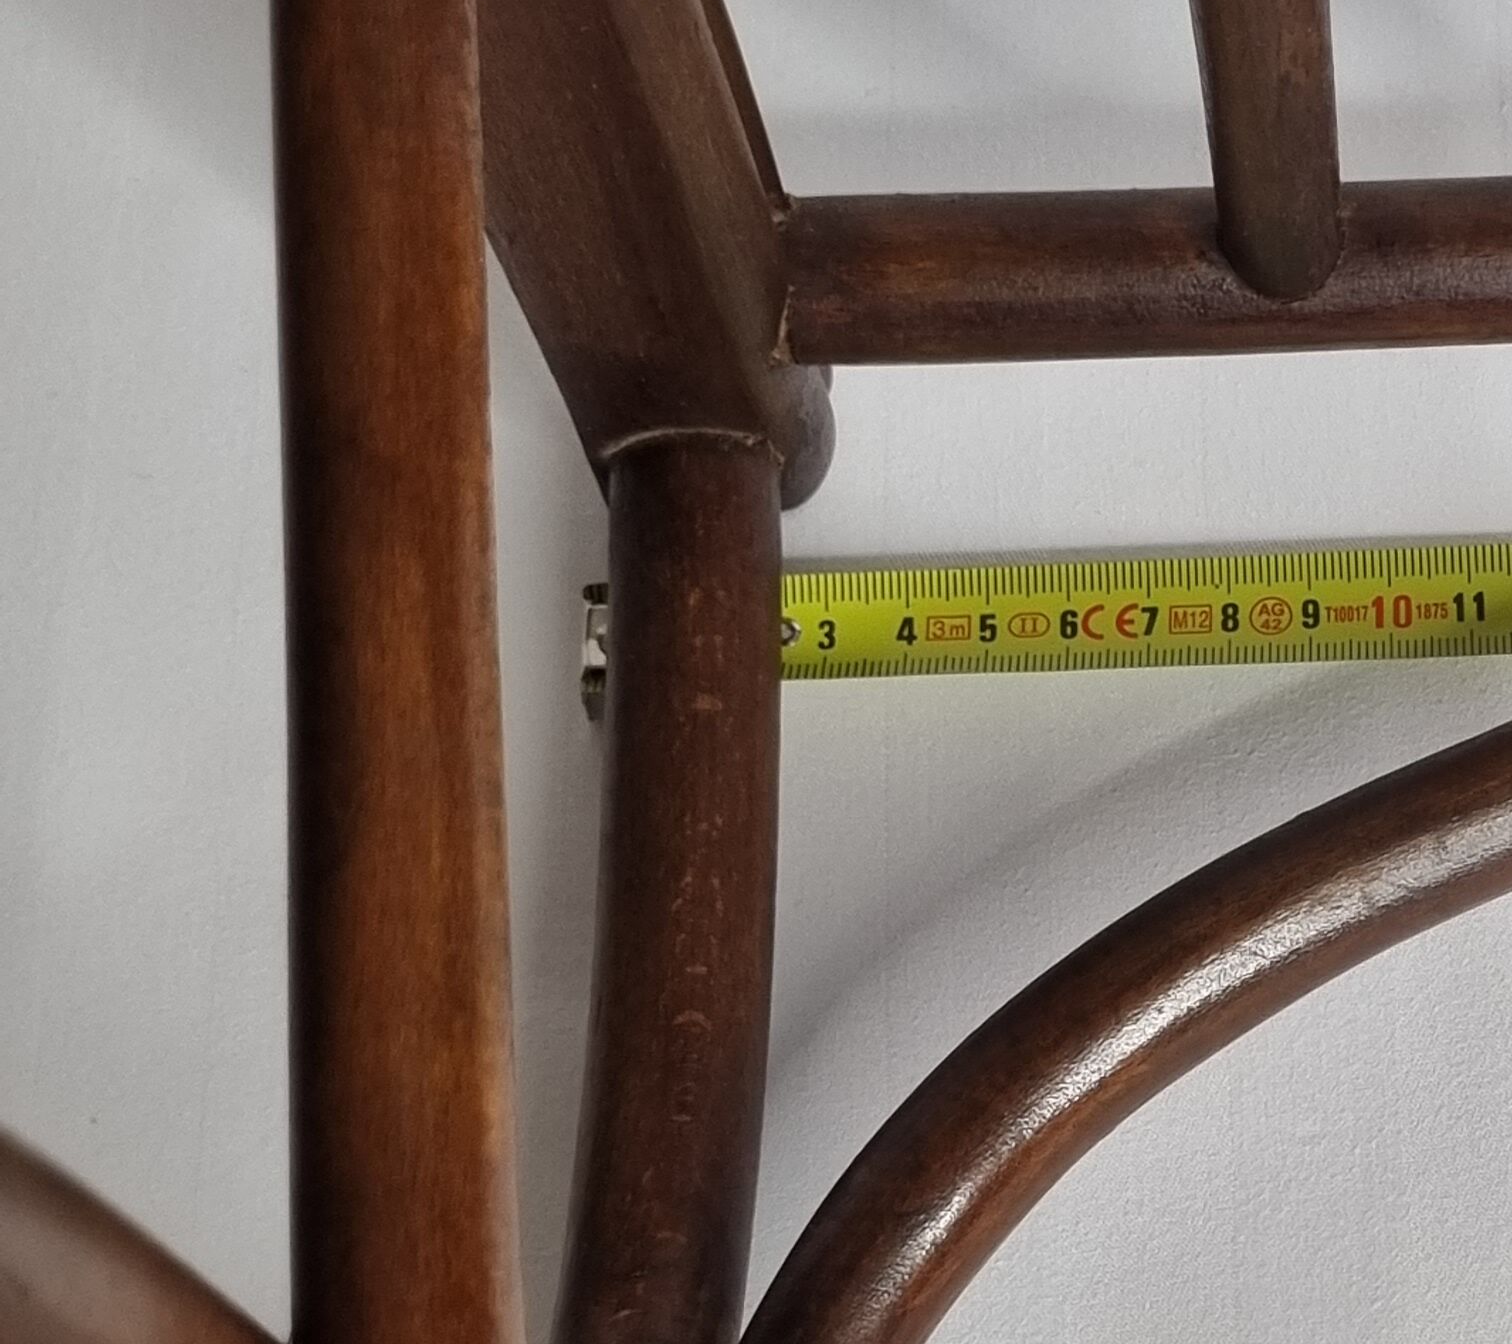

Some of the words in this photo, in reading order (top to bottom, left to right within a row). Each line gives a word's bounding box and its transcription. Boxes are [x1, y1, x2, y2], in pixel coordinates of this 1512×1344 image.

[1258, 603, 1285, 617] AG
[1416, 603, 1448, 619] 1875
[818, 619, 836, 650] 3
[896, 617, 917, 646] 4
[979, 614, 997, 642] 5
[1060, 610, 1078, 640] 6
[1140, 607, 1159, 636] 7
[1221, 603, 1239, 633] 8
[1302, 599, 1320, 629] 9
[1371, 595, 1413, 629] 10
[1453, 591, 1485, 622] 11
[1081, 603, 1139, 640] CE
[1172, 610, 1209, 629] M12
[1259, 618, 1281, 631] 42
